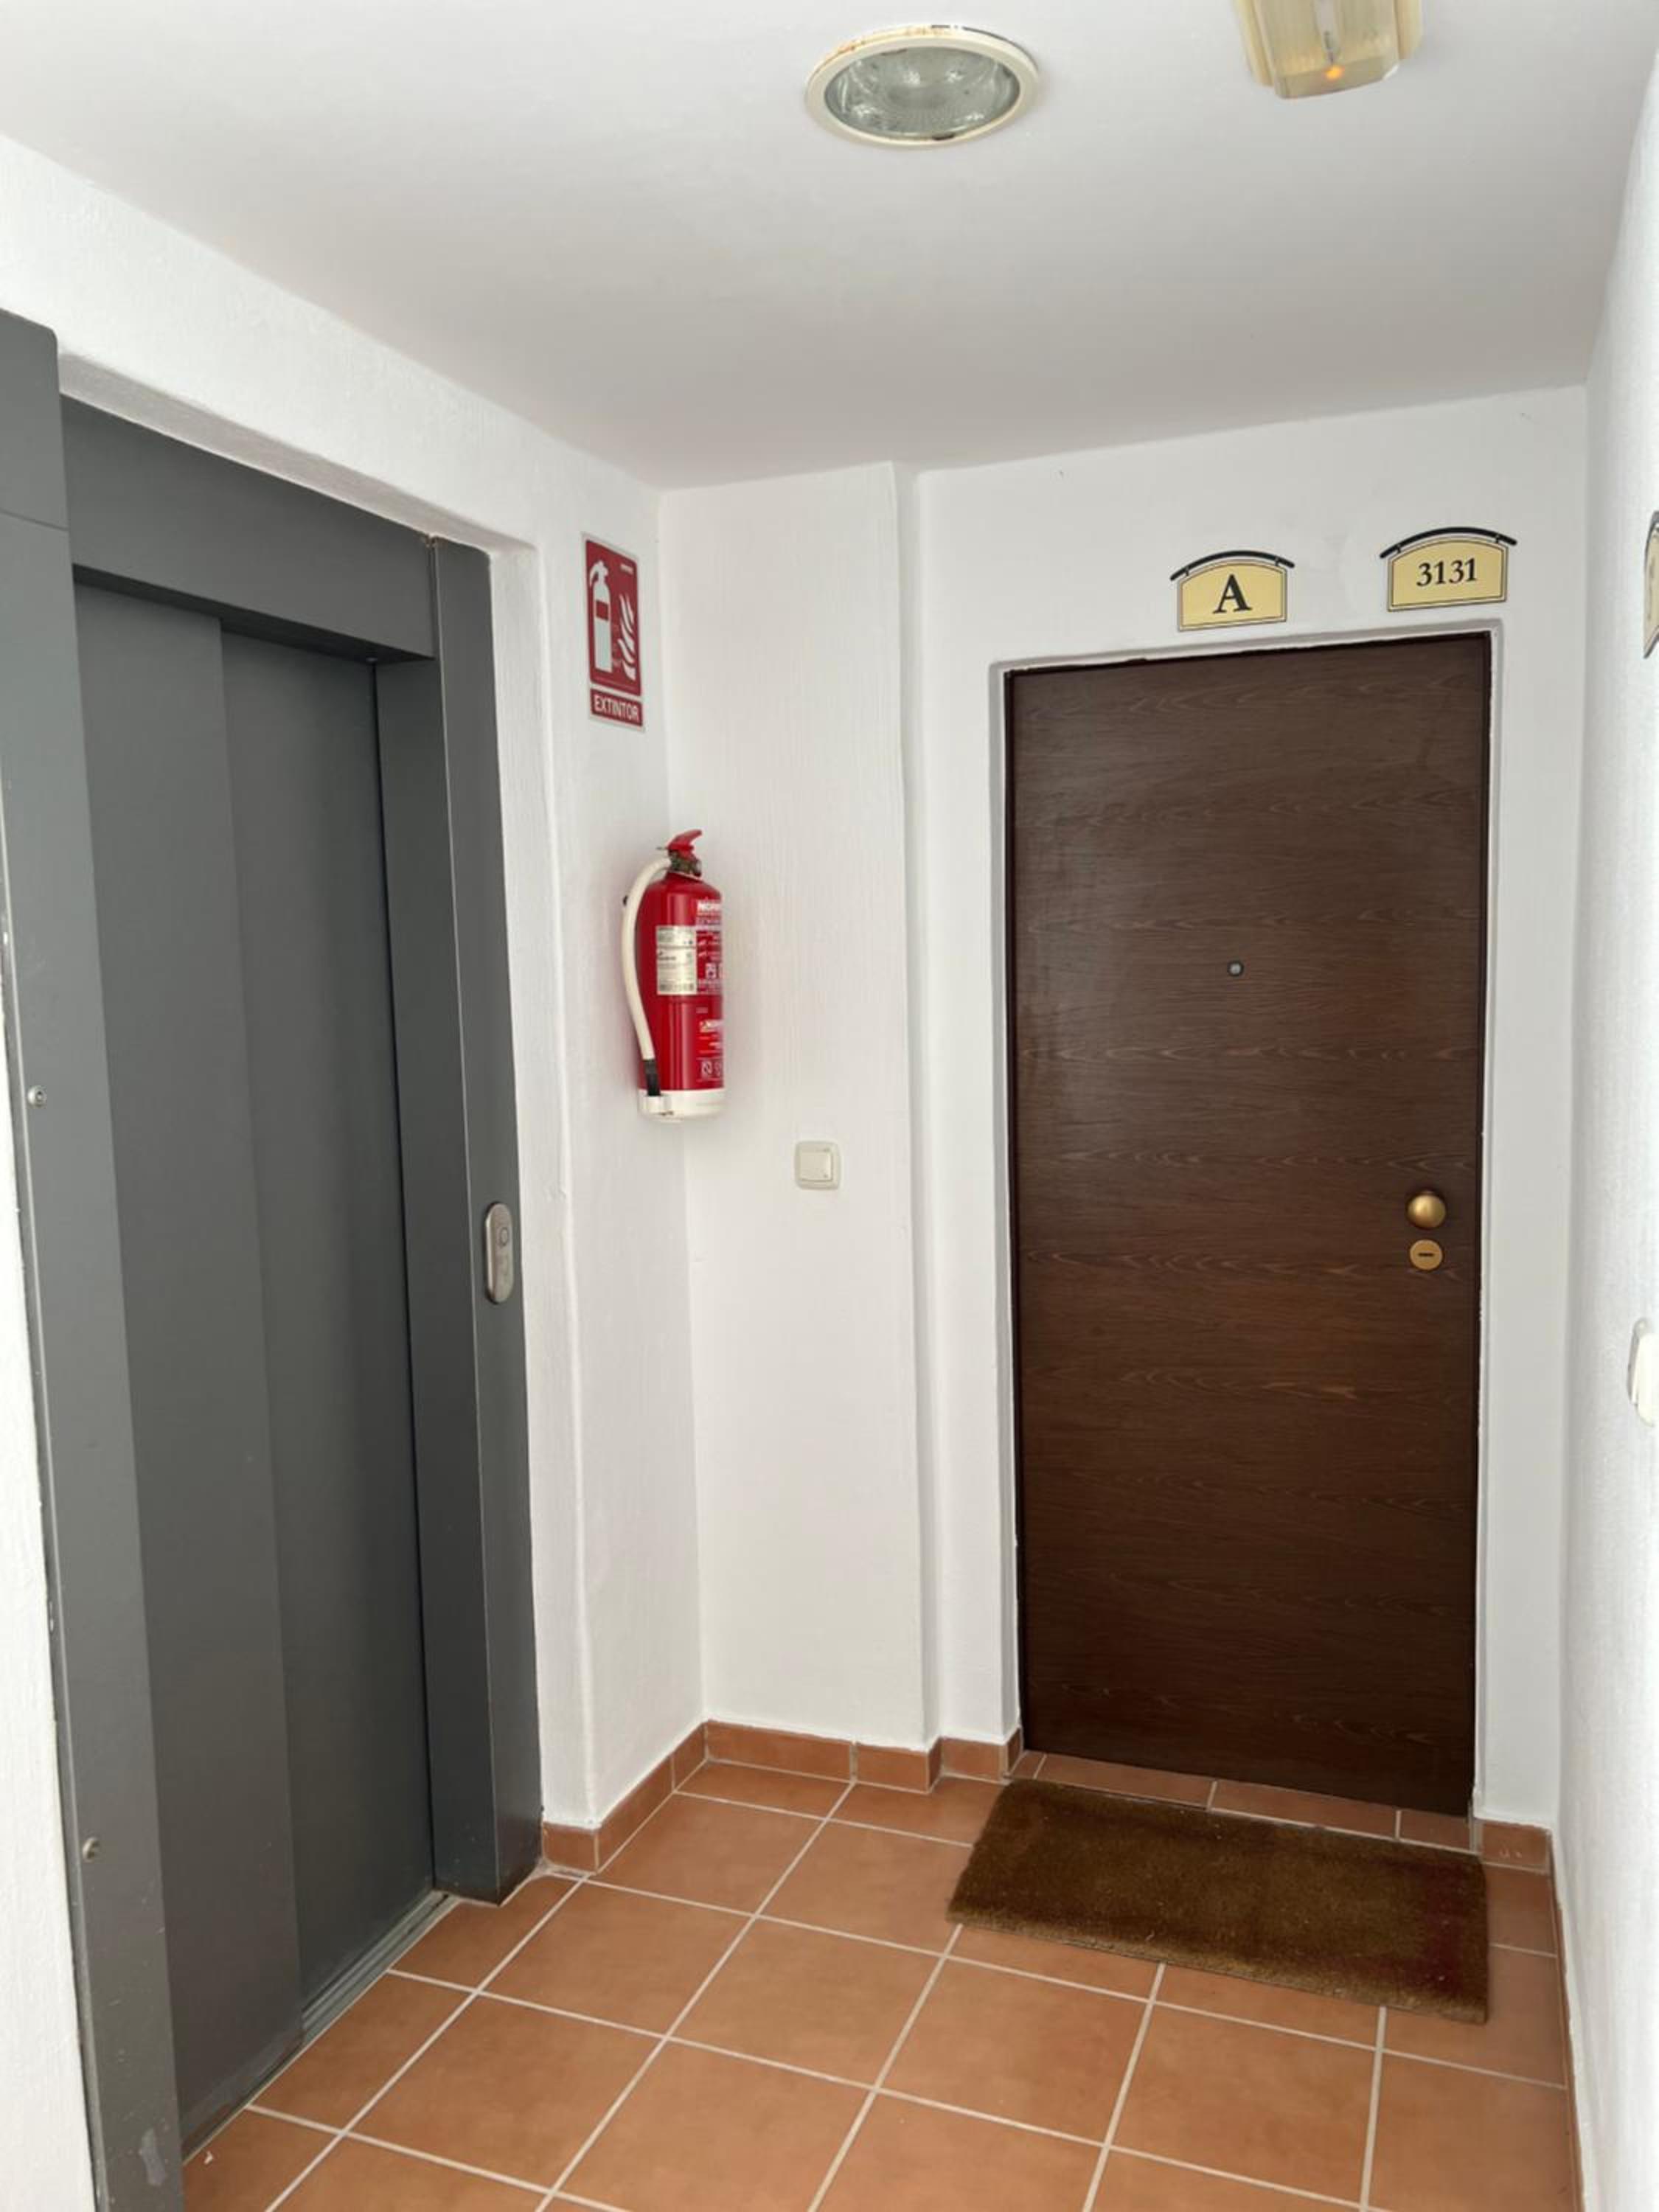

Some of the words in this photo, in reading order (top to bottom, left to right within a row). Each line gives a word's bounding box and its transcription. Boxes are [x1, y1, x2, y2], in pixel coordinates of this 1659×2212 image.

[1416, 557, 1477, 587] 3131
[1212, 574, 1253, 614] A
[594, 695, 640, 722] EXTINTOR
